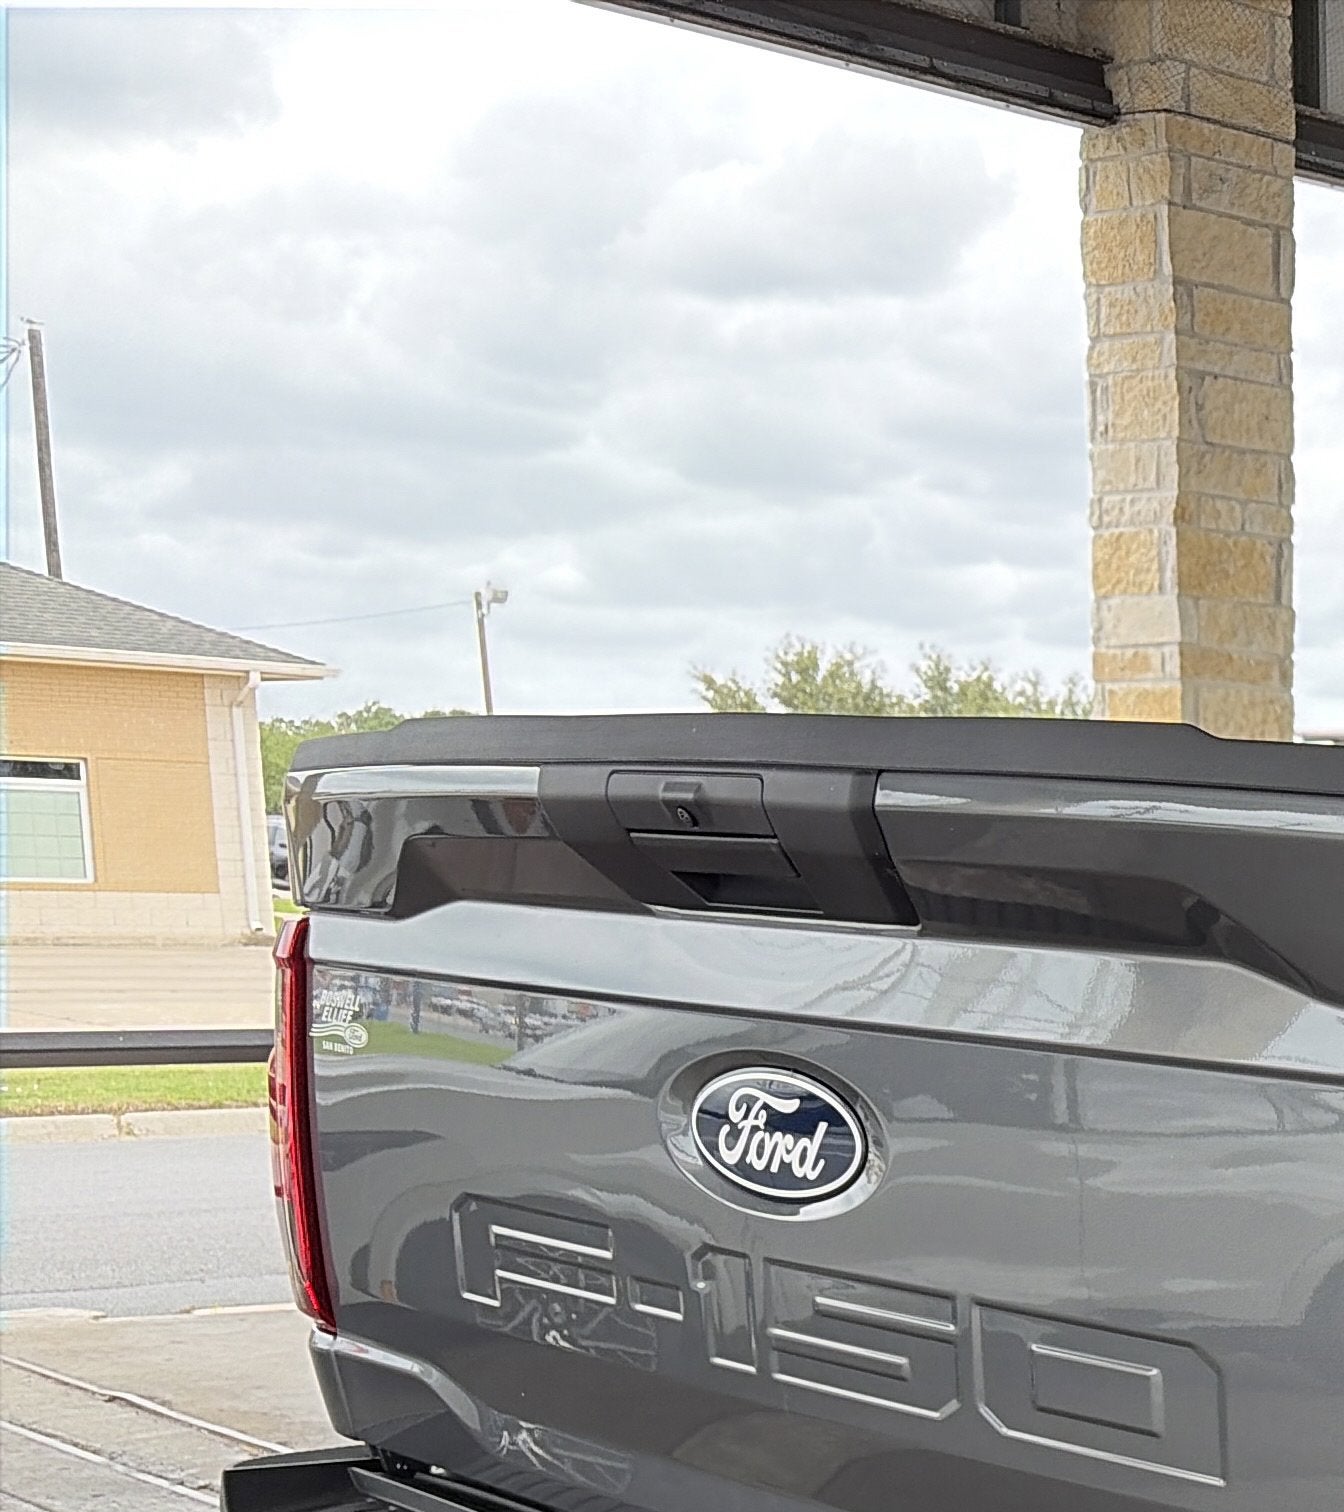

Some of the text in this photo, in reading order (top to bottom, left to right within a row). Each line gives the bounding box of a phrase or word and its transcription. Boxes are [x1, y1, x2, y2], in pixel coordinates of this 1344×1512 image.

[320, 989, 360, 1012] BOSWELL
[322, 1007, 353, 1024] ELLIFF
[323, 1040, 354, 1055] SAN BENITO
[718, 1086, 828, 1182] Ford
[453, 1191, 1227, 1486] F-150
